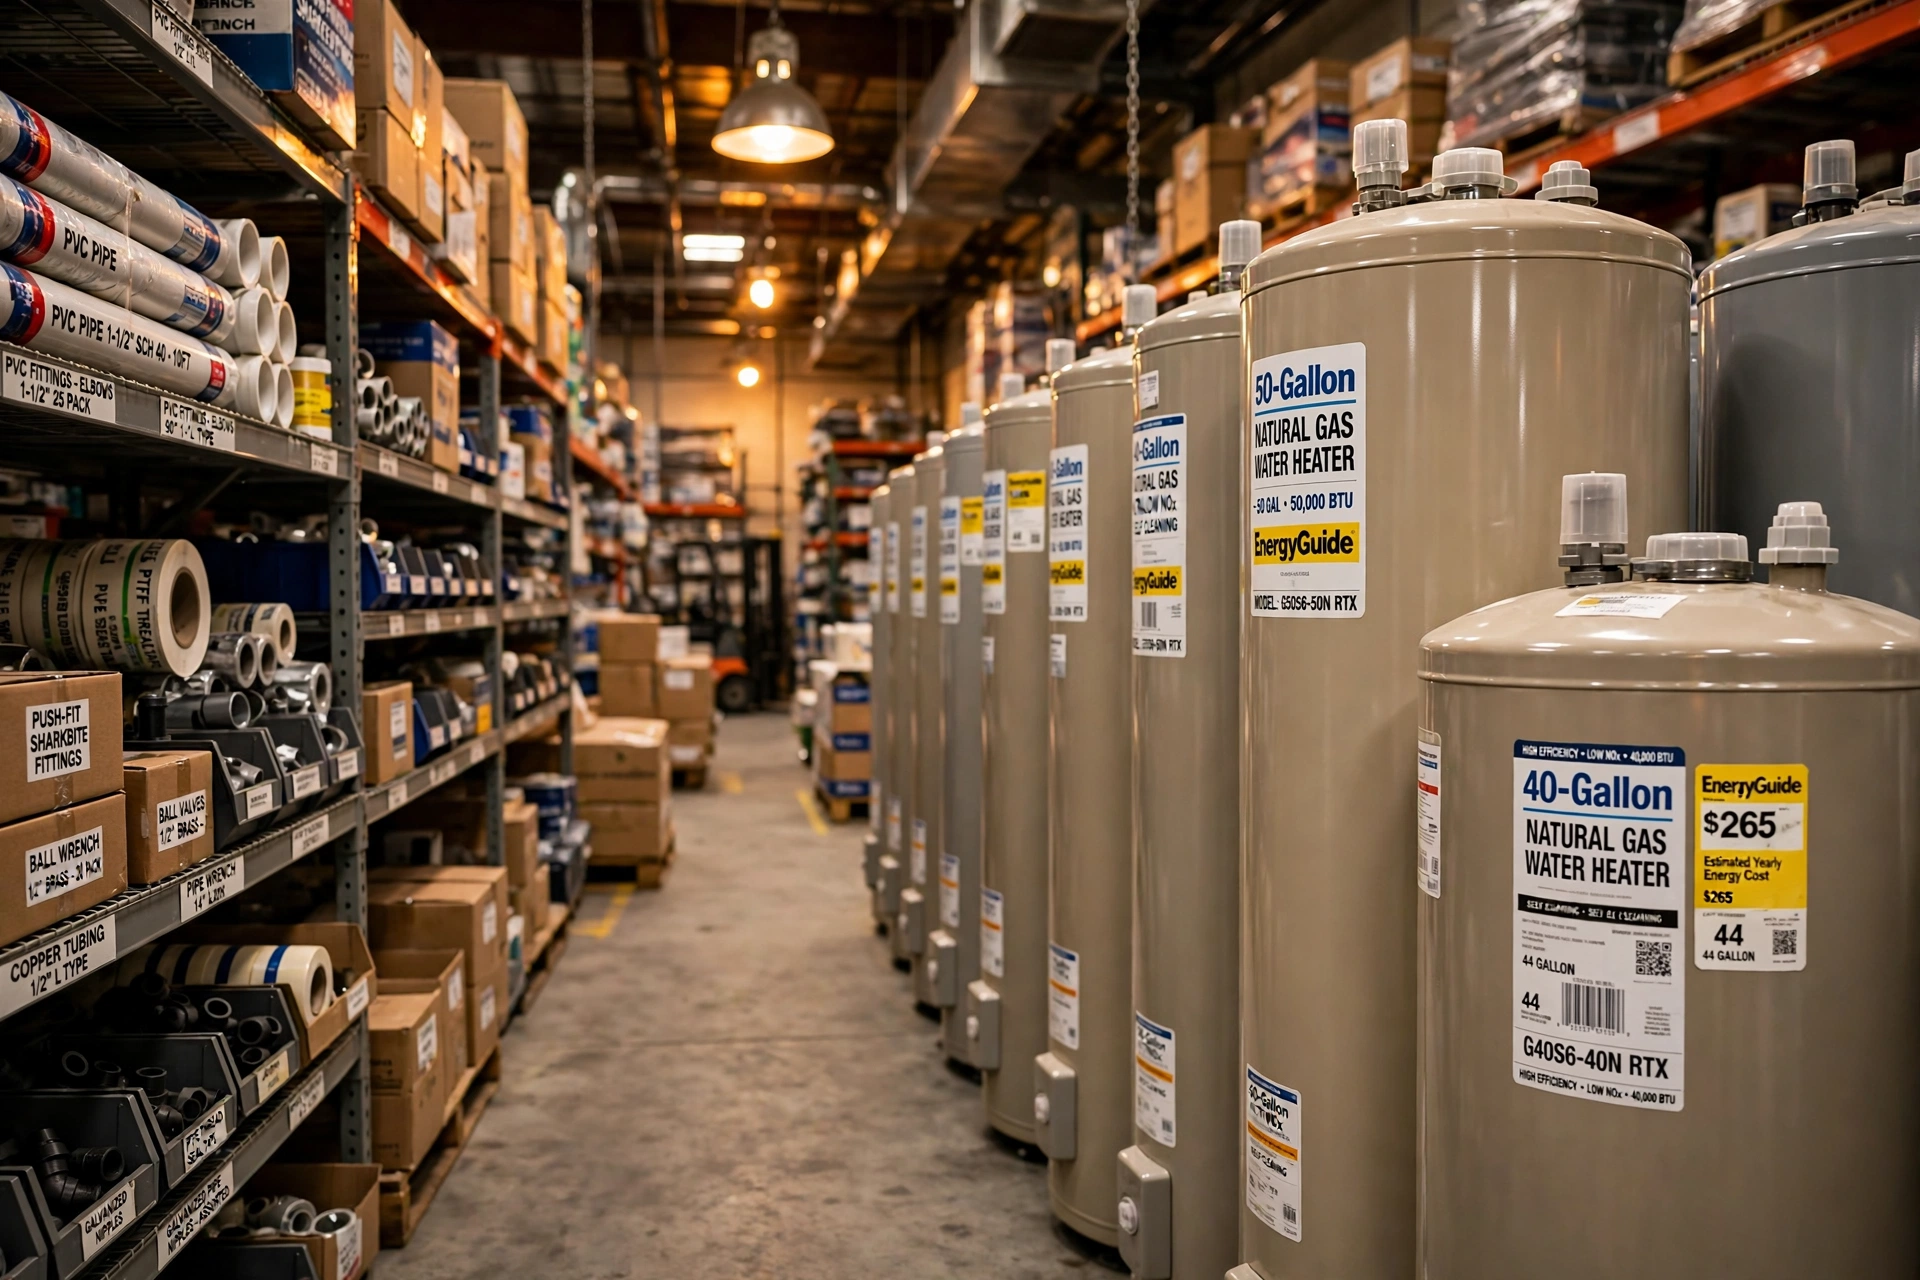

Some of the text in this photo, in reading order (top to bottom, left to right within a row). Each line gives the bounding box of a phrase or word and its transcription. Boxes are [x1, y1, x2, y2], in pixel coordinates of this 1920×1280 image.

[63, 226, 117, 272] PVC PIPE
[51, 304, 76, 333] PVC
[79, 313, 104, 342] PIPE
[107, 323, 134, 350] 1-1/2"
[135, 335, 154, 358] SCH
[155, 341, 166, 362] 40
[173, 348, 191, 370] 10FT
[5, 355, 27, 377] PVC
[30, 362, 72, 389] FITTINGS
[1255, 364, 1355, 406] 50-Gallon
[20, 380, 91, 415] 1-1/2" 25 PACK
[1255, 411, 1354, 449] NATURAL GAS
[1254, 445, 1355, 479] WATER HEATER
[1159, 469, 1178, 489] GAS
[1266, 496, 1281, 513] GAL
[1290, 493, 1325, 514] 50,000
[1329, 491, 1353, 509] BTU
[1254, 529, 1354, 562] EnergyGuide
[1334, 595, 1357, 611] RTX
[32, 704, 81, 729] PUSH-FIT
[30, 725, 88, 752] SHARKBITE
[34, 748, 82, 774] FITTINGS
[1587, 748, 1604, 760] LOW
[1657, 752, 1674, 764] BTU
[1523, 770, 1673, 810] 40-Gallon
[159, 795, 205, 824] BALL VALVES
[1703, 810, 1776, 839] $265
[1526, 818, 1667, 855] NATURAL GAS
[29, 848, 57, 873] BALL
[58, 832, 100, 863] WRENCH
[1704, 856, 1782, 871] Estimated Yearly
[1525, 849, 1670, 888] WATER HEATER
[1704, 869, 1769, 884] Energy Cost
[187, 876, 204, 898] PIPE
[1703, 890, 1733, 904] $265
[1714, 924, 1744, 946] 44
[10, 924, 105, 982] COPPER TUBING
[1522, 954, 1575, 975] 44 GALLON
[1702, 950, 1755, 961] 44 GALLON
[31, 953, 88, 996] 1/2" L TYPE
[1521, 991, 1540, 1011] 44
[1523, 1035, 1669, 1080] G40S6-40N RTX
[1519, 1068, 1676, 1104] HIGH EFFICIENCY LOW NOx 40,000 BTU
[85, 1190, 127, 1234] GALVANIZED
